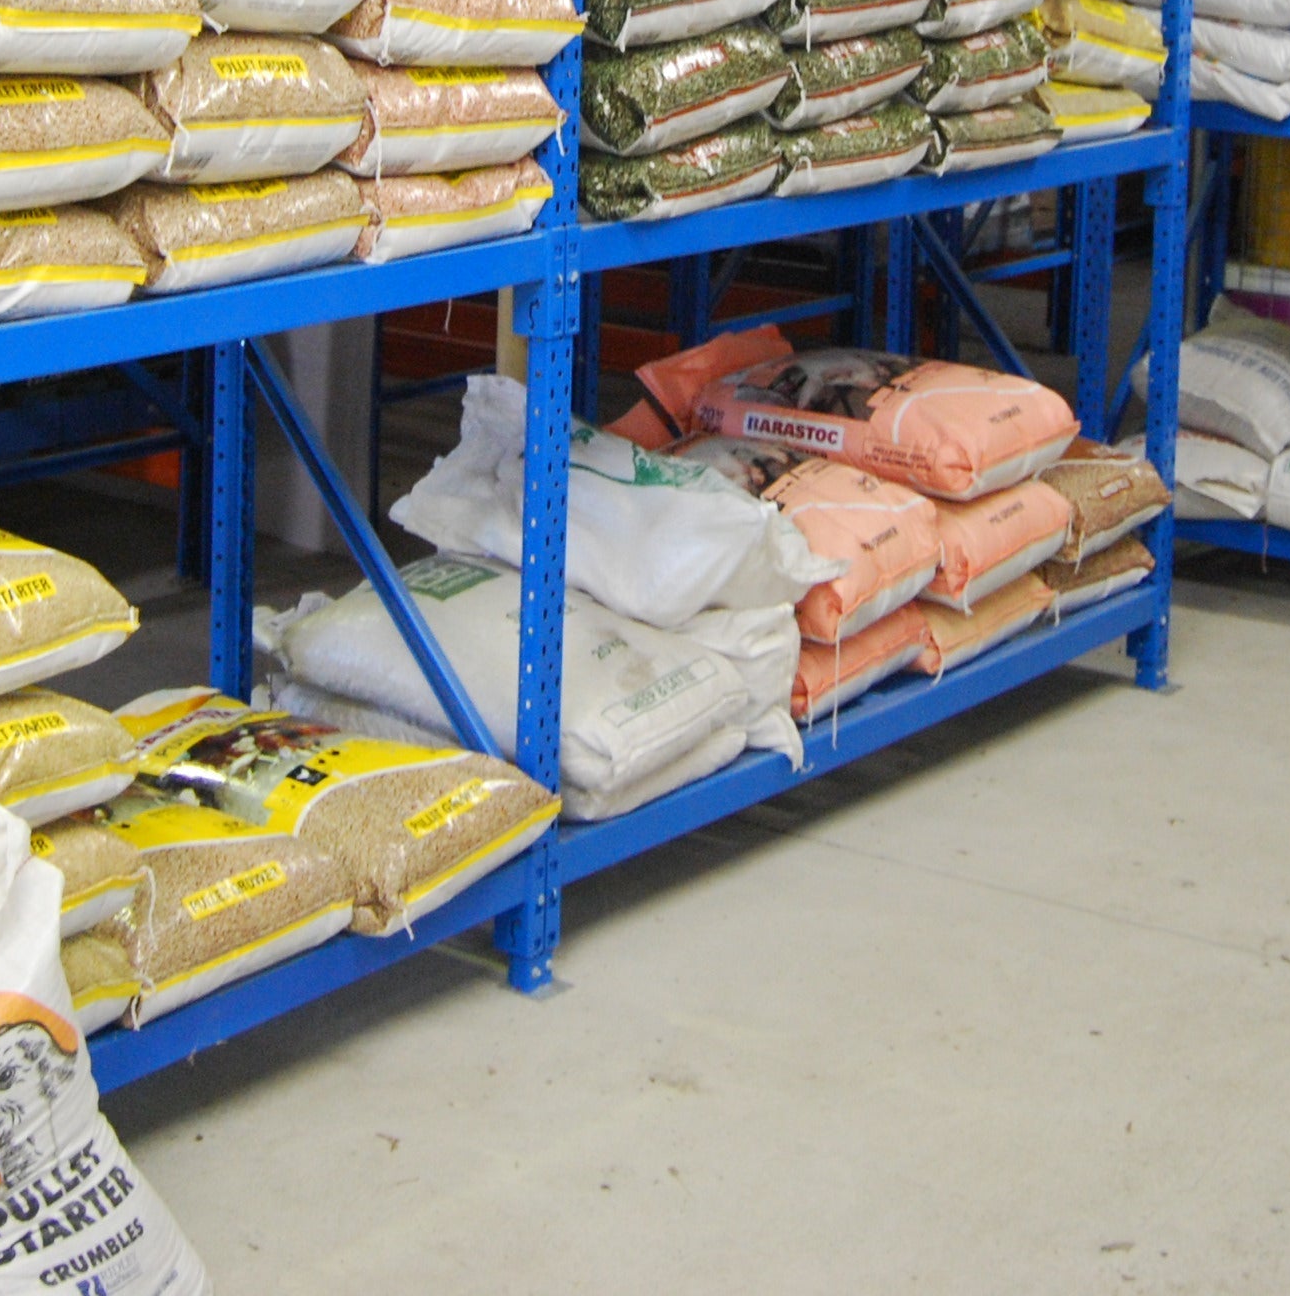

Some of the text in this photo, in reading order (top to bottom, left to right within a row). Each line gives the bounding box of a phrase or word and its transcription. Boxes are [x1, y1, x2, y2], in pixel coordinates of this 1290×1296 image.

[22, 81, 77, 99] GROWER
[745, 414, 840, 446] BARASTOC
[11, 714, 68, 740] STARTER
[38, 1216, 146, 1288] CRUMBLES
